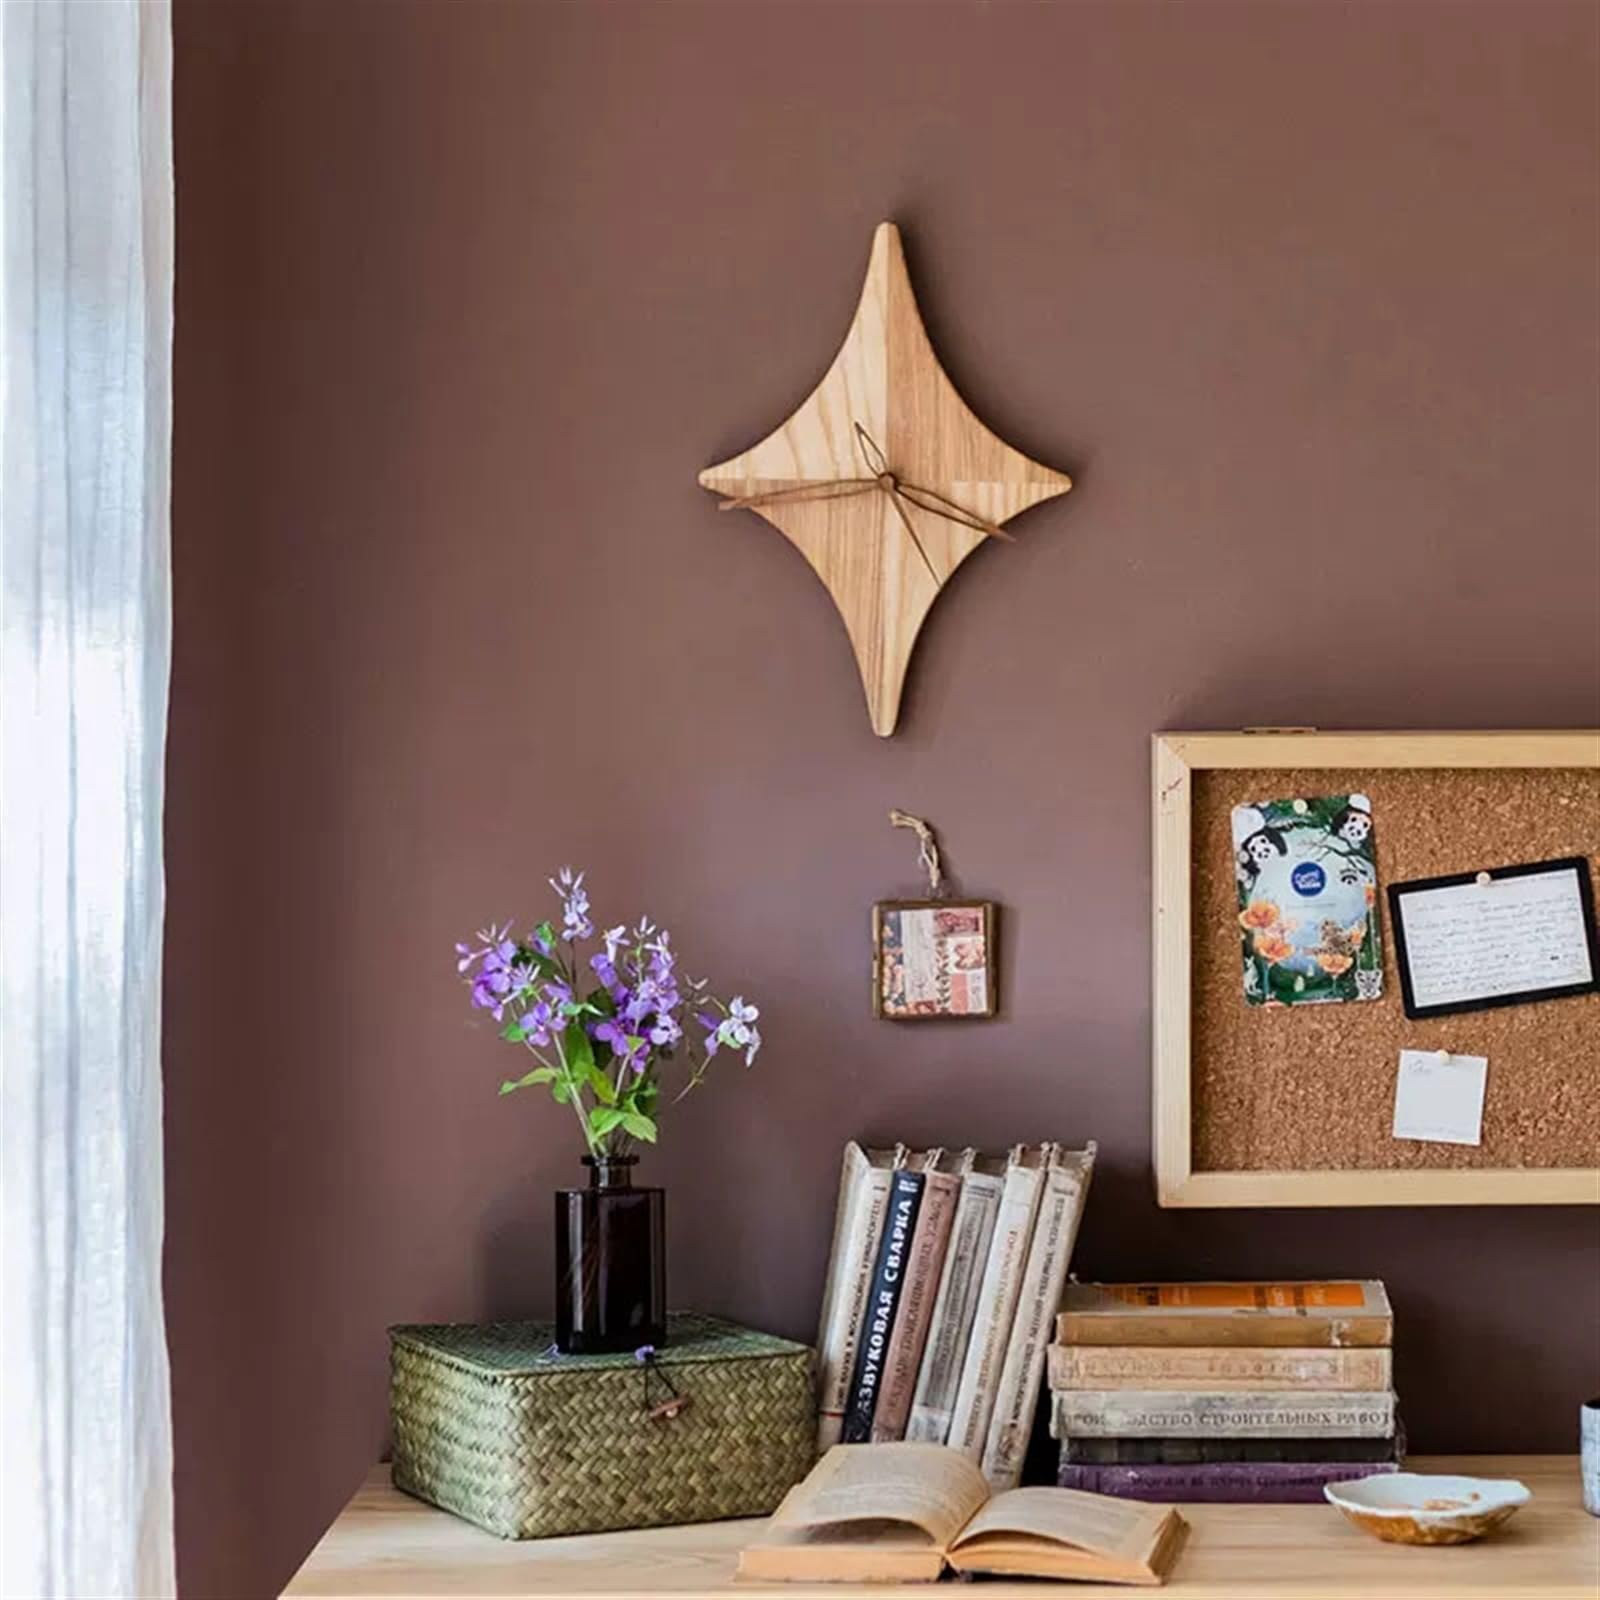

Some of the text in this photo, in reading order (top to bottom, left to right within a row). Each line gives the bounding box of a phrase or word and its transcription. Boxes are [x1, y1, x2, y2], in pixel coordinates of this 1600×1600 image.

[852, 1197, 912, 1423] АЗВУКОВАЯ СВАРКА
[1199, 1411, 1331, 1425] СТРОИТЕЛЬНЫХ
